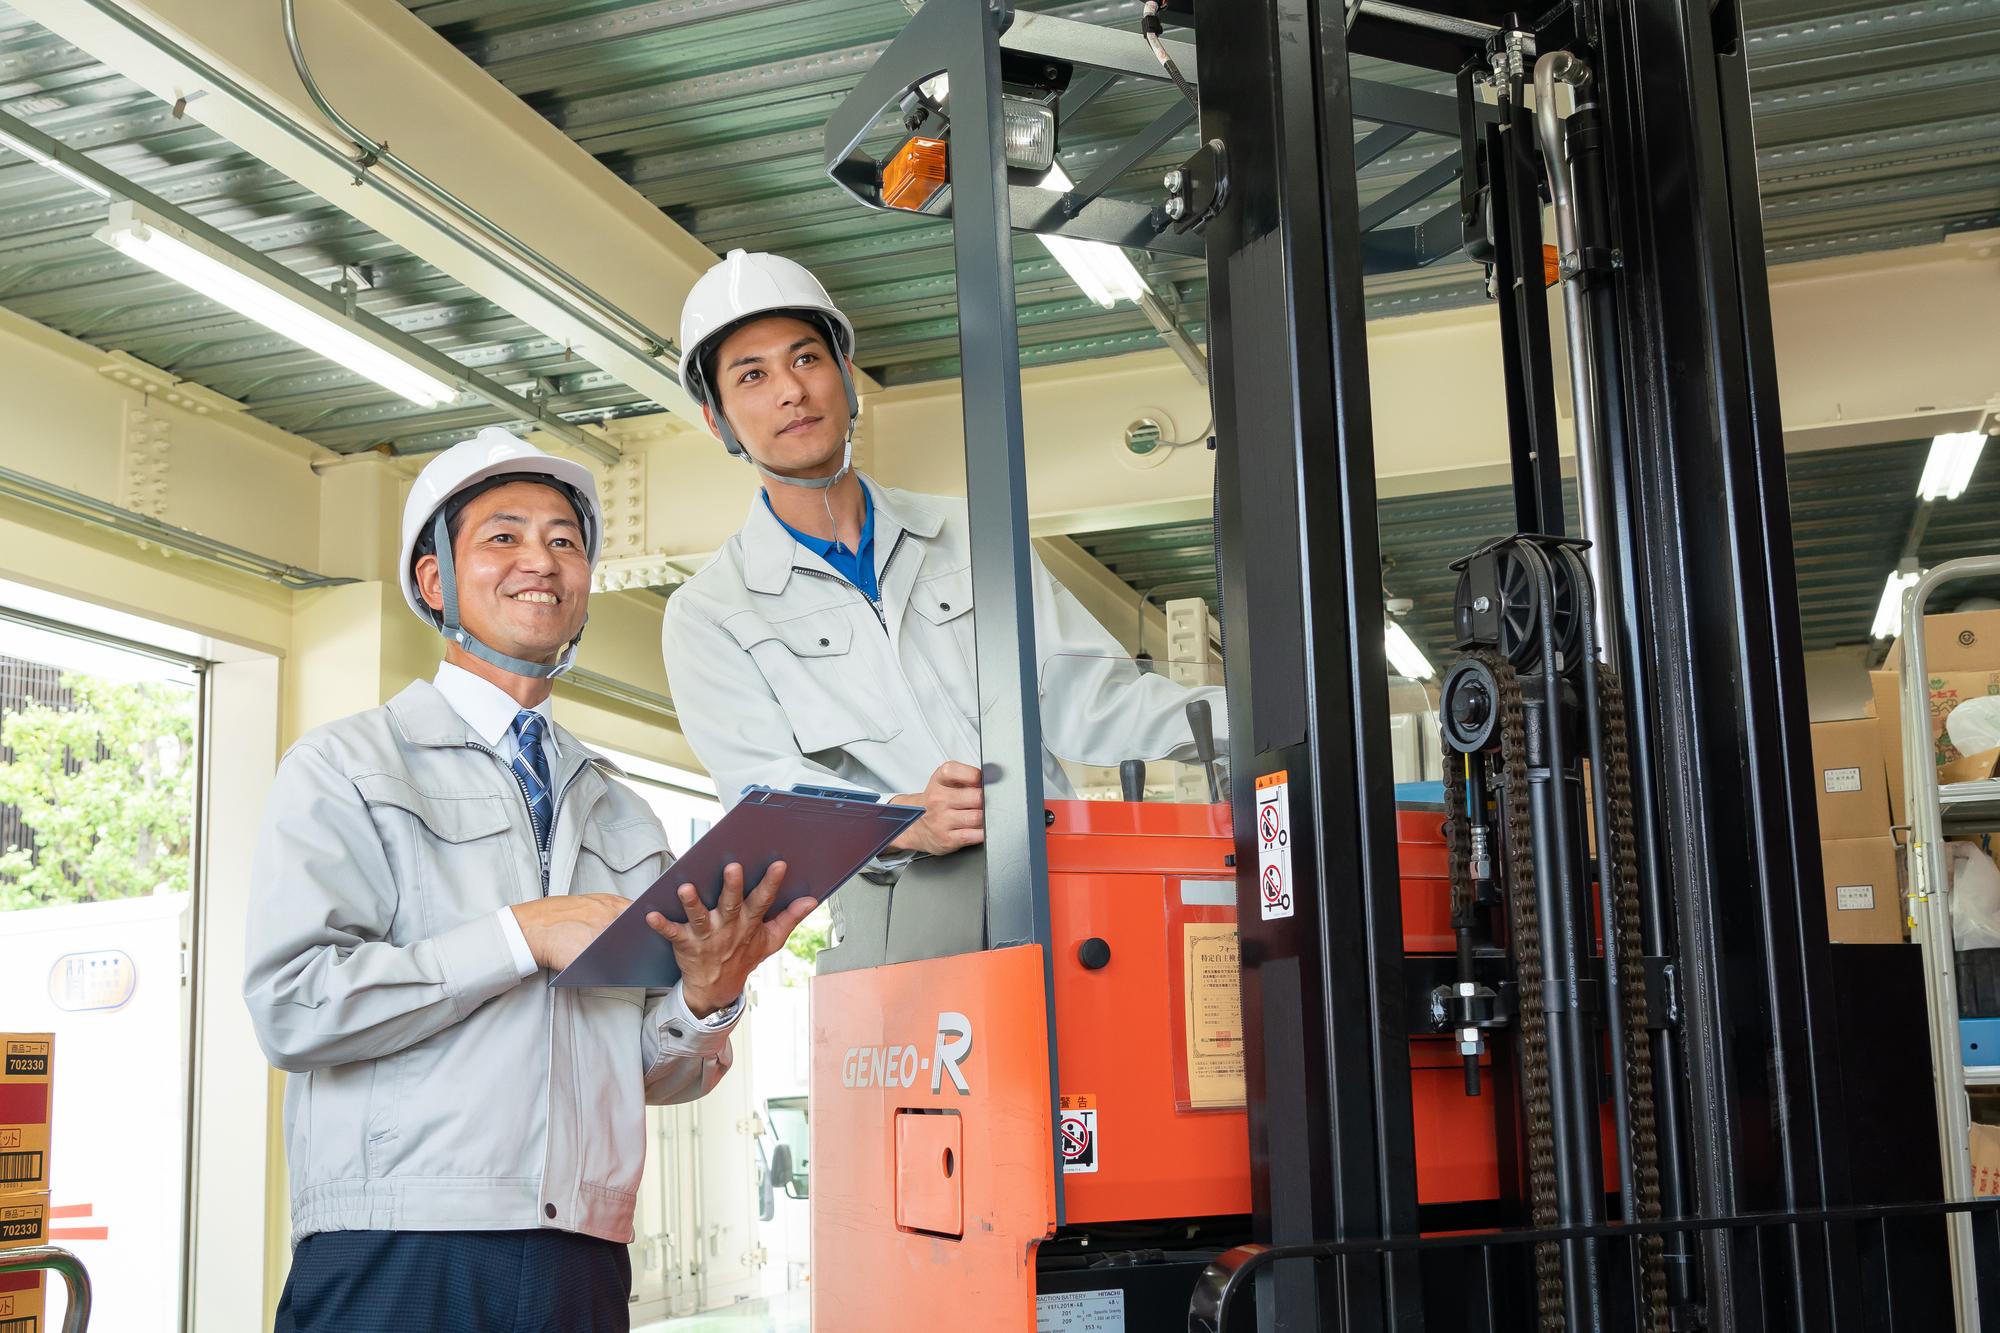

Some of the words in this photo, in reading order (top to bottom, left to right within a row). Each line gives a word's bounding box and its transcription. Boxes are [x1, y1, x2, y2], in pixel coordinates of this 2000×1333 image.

[11, 1043, 47, 1053] 商品コード
[842, 1011, 973, 1096] GENEO-R
[10, 1059, 44, 1070] 702330
[1060, 1096, 1088, 1108] 警告
[4, 1207, 40, 1218] 商品コード
[3, 1223, 38, 1236] 702330
[1036, 1294, 1060, 1302] RACTION
